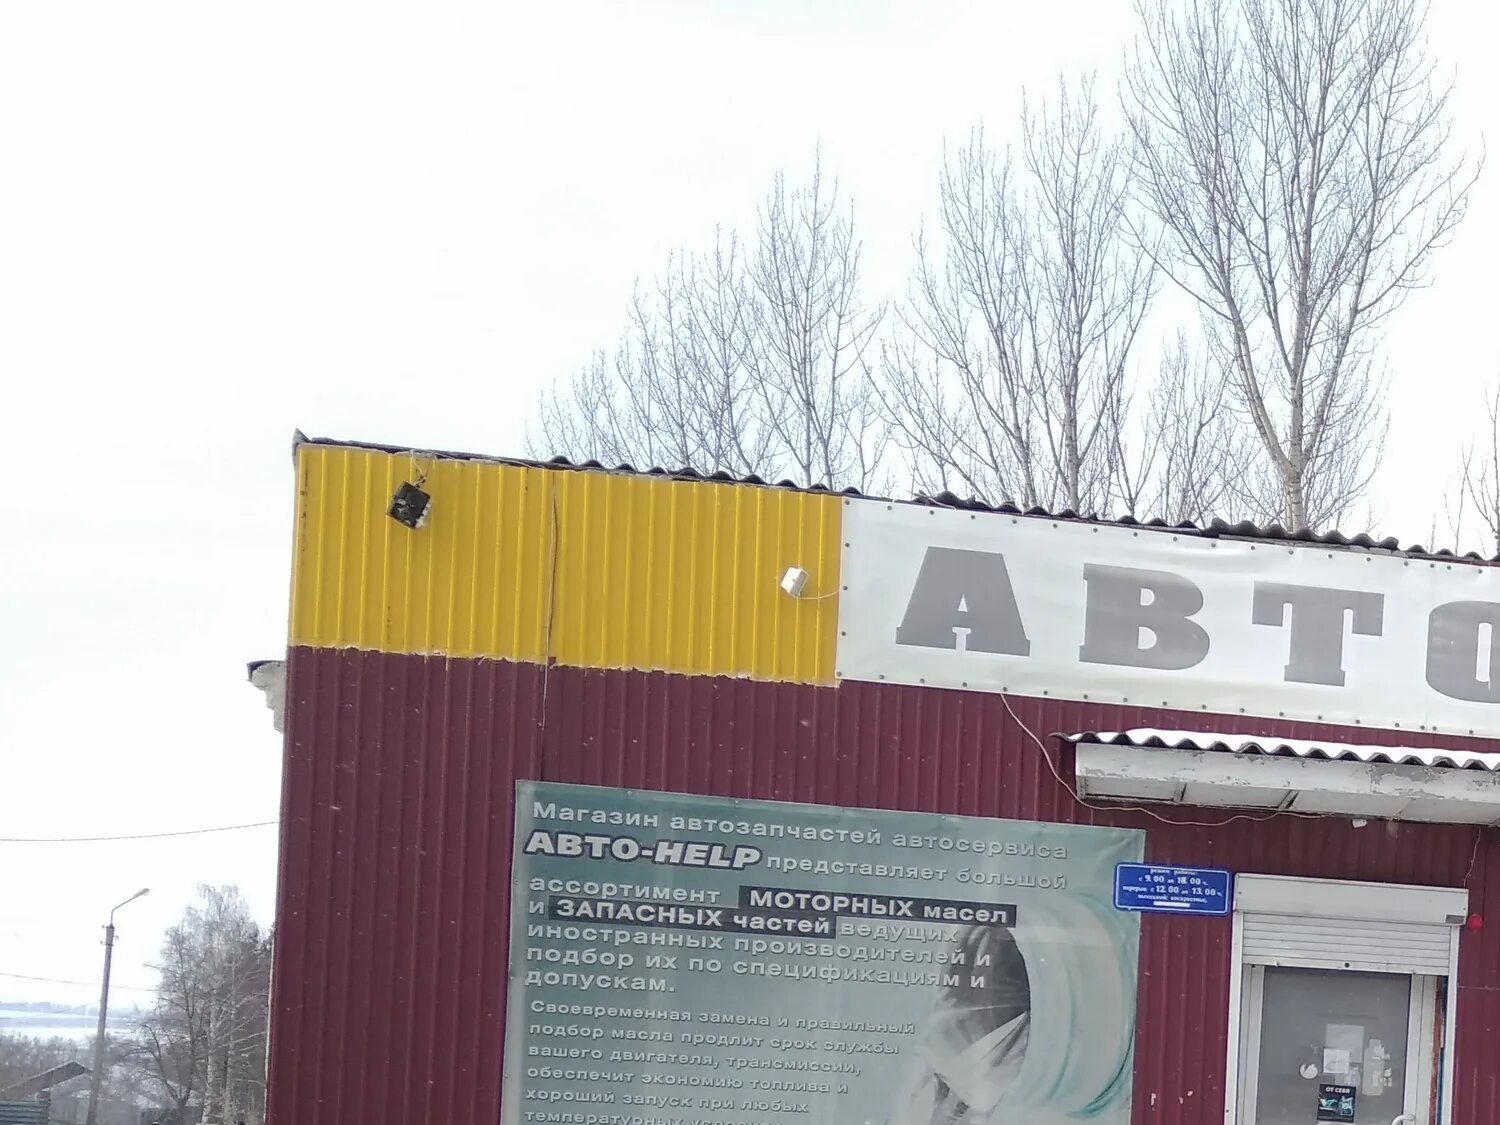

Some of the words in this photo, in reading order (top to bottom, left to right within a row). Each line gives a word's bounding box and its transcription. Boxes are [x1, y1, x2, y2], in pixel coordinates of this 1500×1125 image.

[532, 802, 659, 828] Магазин
[669, 814, 882, 845] автозапчастей
[892, 832, 1067, 859] автосервиса
[525, 830, 762, 869] АВТО-HELP
[766, 854, 948, 882] представляет
[955, 866, 1067, 890] большой
[529, 877, 722, 904] ассортимент
[750, 890, 913, 917] МОТОРНЫХ
[923, 904, 1007, 923] масел
[529, 900, 545, 915] и
[556, 899, 723, 927] ЗАПАСНЫХ
[733, 913, 830, 934] частей
[840, 923, 959, 943] ведущих
[528, 923, 723, 950] иностранных
[734, 936, 965, 967] производителей
[974, 953, 991, 968] и
[524, 968, 676, 993] допускам.
[527, 947, 634, 969] подбор
[645, 954, 678, 970] их
[688, 957, 722, 973] по
[732, 960, 960, 988] спецификациям
[969, 975, 985, 989] и
[531, 1000, 692, 1021] Своевременная
[698, 1011, 771, 1027] замена
[777, 1017, 788, 1027] и
[795, 1017, 915, 1035] правильный
[529, 1023, 604, 1040] подбор
[611, 1028, 674, 1042] масла
[680, 1032, 764, 1047] продлит
[769, 1038, 817, 1051] срок
[823, 1039, 900, 1055] службы
[528, 1045, 603, 1059] вашего
[609, 1049, 720, 1069] двигателя,
[726, 1056, 862, 1076] трансмиссии,
[527, 1066, 635, 1083] обеспечит
[641, 1074, 743, 1089] экономию
[749, 1079, 831, 1093] топлива
[837, 1084, 849, 1094] и
[525, 1088, 615, 1103] хороший
[622, 1095, 693, 1108] запуск
[698, 1098, 735, 1110] при
[740, 1100, 809, 1113] любых
